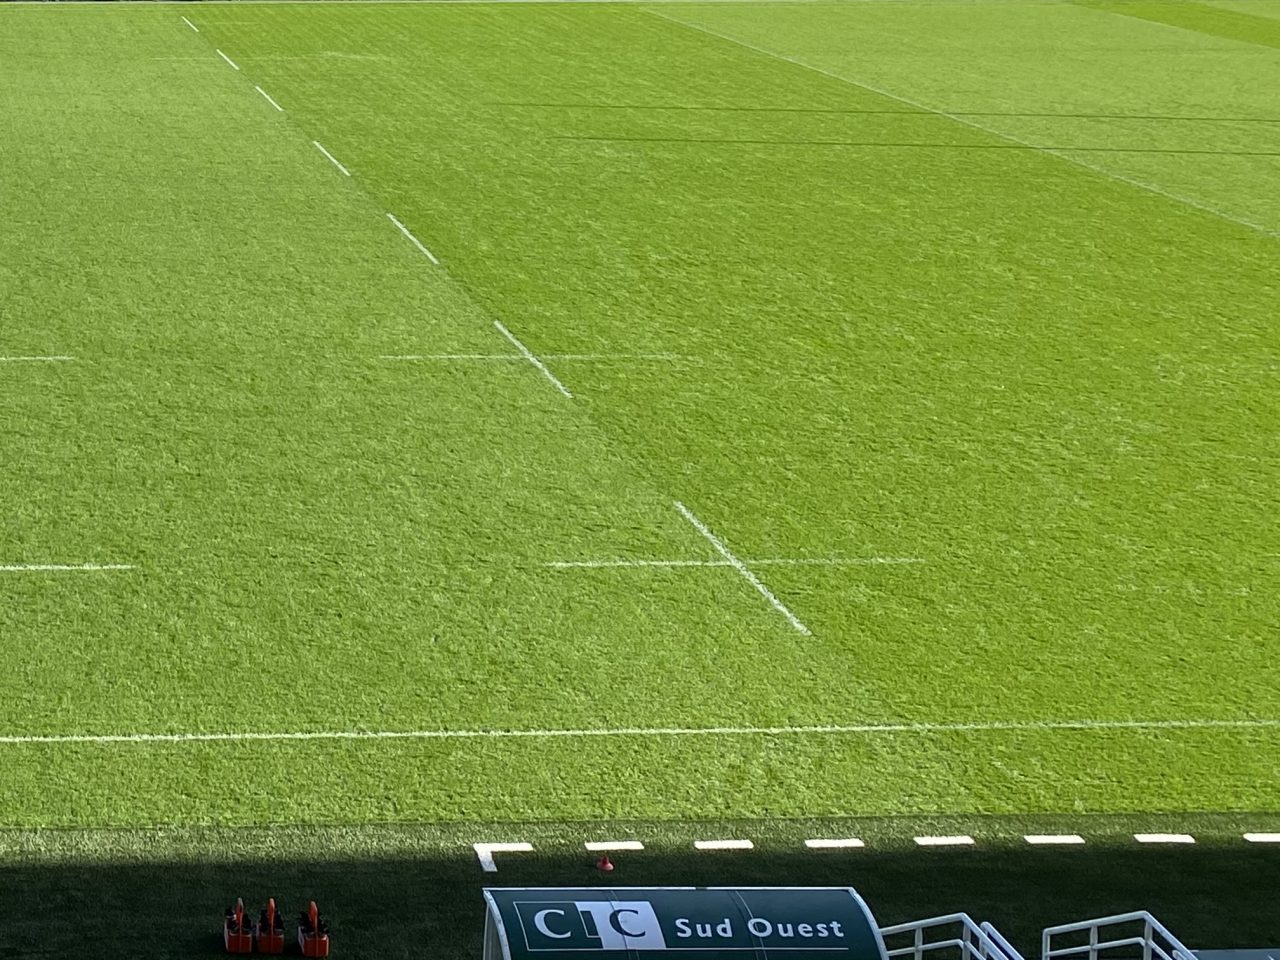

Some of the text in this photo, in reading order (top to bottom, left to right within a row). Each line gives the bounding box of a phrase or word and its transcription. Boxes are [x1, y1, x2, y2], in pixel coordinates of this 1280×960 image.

[533, 909, 845, 939] CIC Sud Ouest
